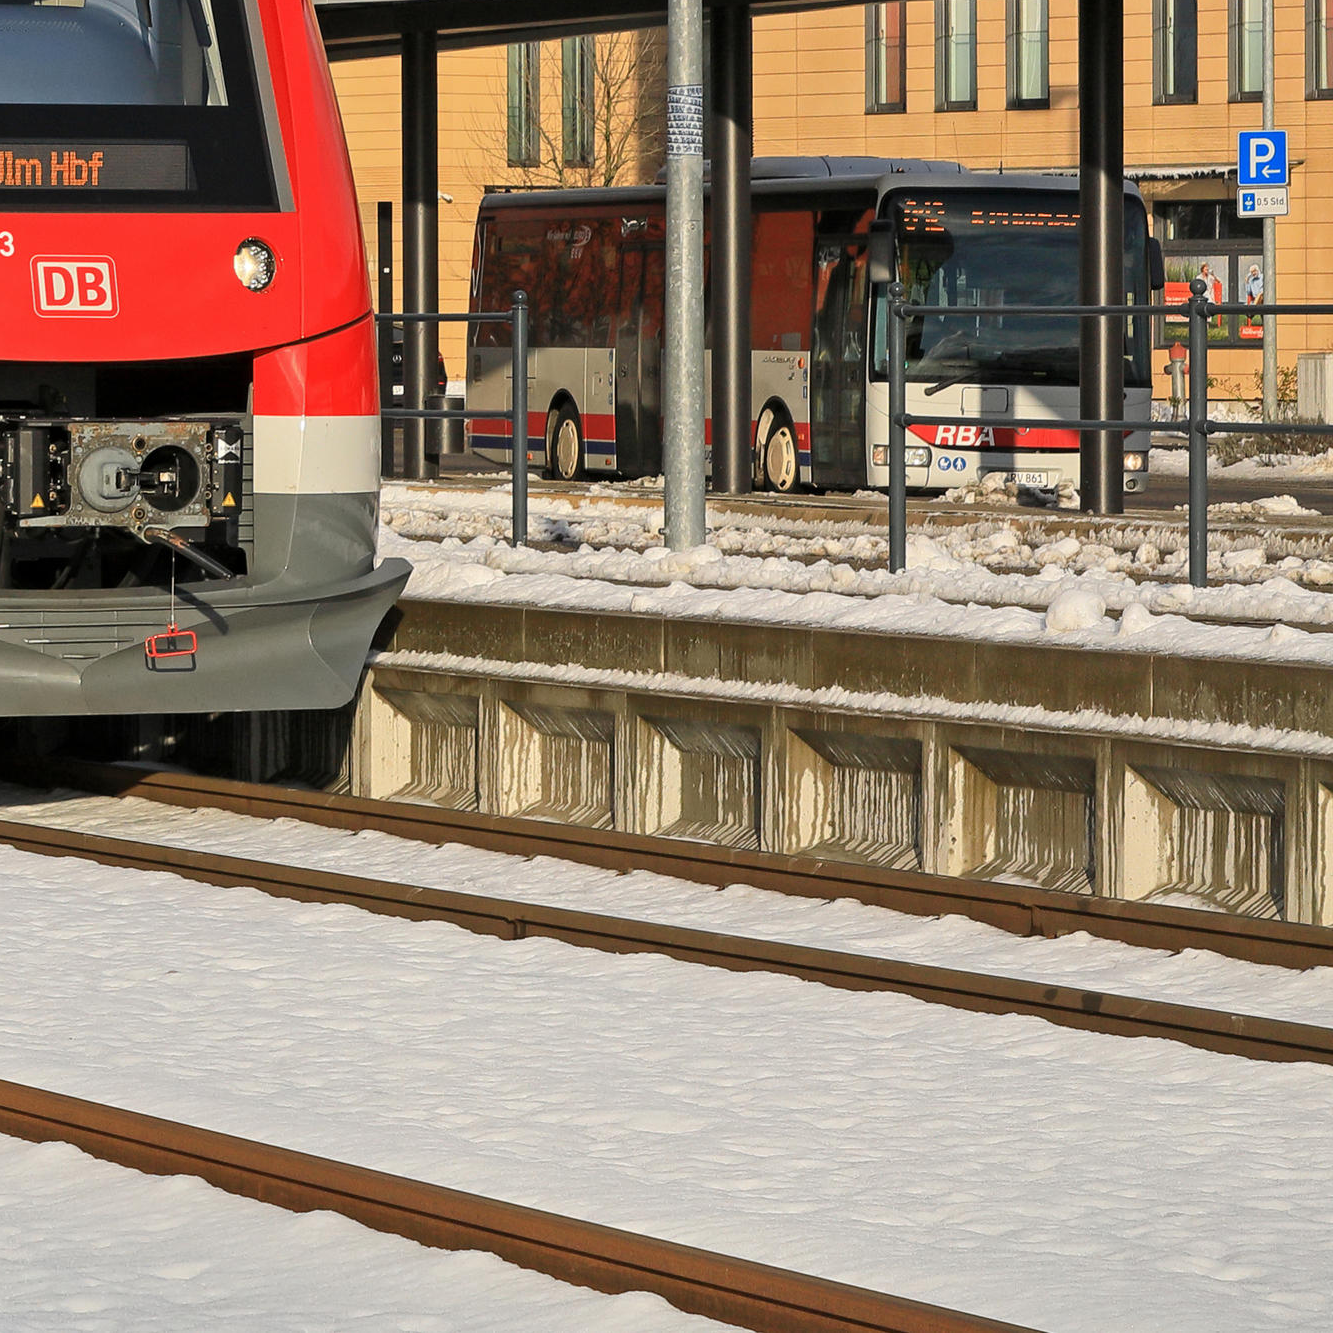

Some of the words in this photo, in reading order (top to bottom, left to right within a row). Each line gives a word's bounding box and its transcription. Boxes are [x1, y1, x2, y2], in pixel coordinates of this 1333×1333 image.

[50, 150, 105, 186] Hbf
[1249, 137, 1276, 178] P
[42, 265, 109, 307] DB
[934, 424, 996, 447] RBA
[1025, 473, 1043, 484] 861
